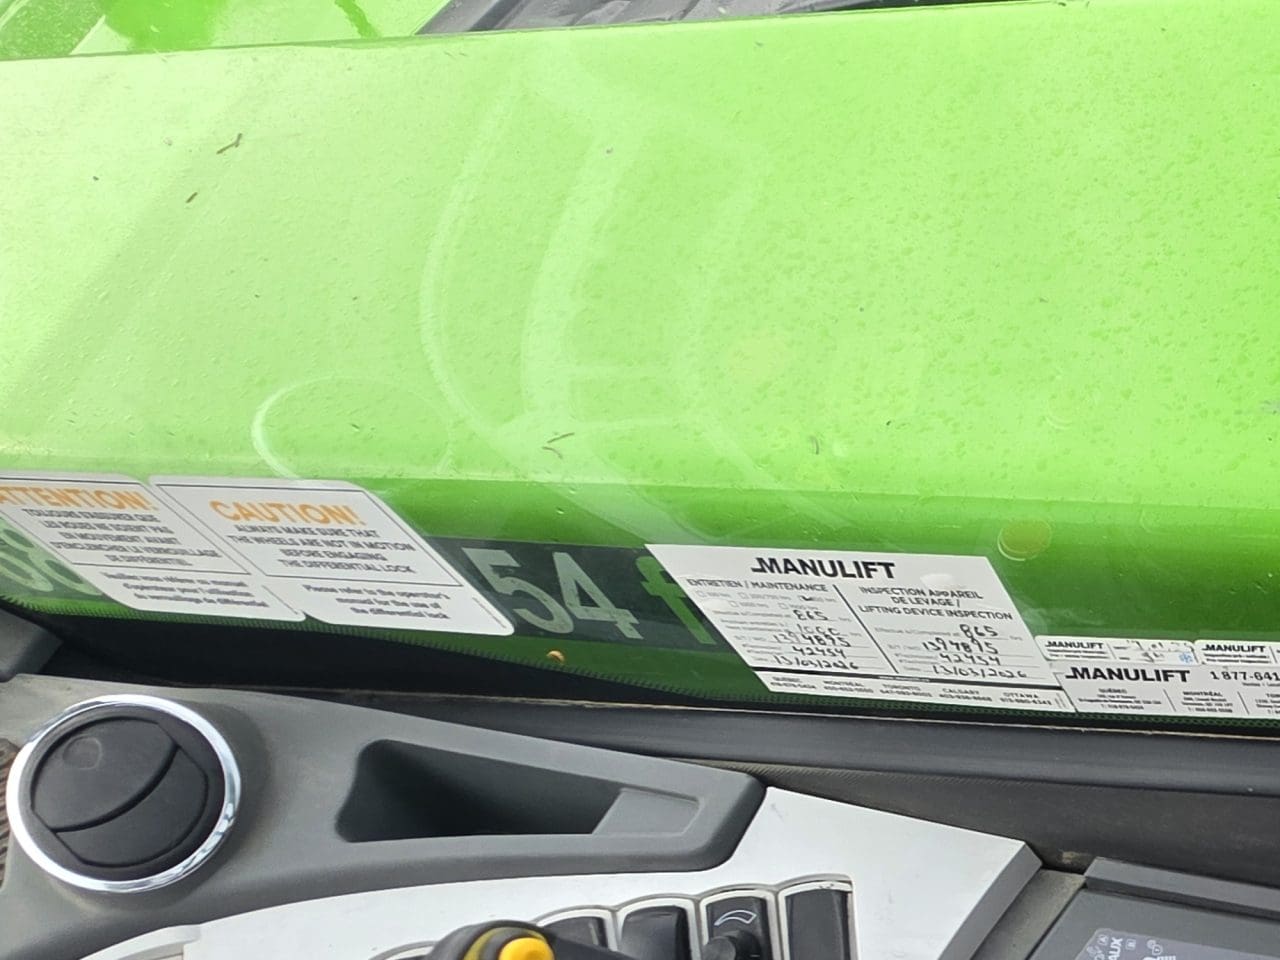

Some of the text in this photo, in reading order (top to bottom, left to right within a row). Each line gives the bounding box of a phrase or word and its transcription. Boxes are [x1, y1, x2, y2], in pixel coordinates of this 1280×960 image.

[209, 500, 367, 526] CAUTION!
[751, 557, 896, 579] MANULIFT
[461, 547, 644, 640] 54
[1045, 640, 1104, 650] MANULIFT
[1202, 644, 1266, 653] MANULIFT
[1065, 666, 1191, 683] MANULIFT
